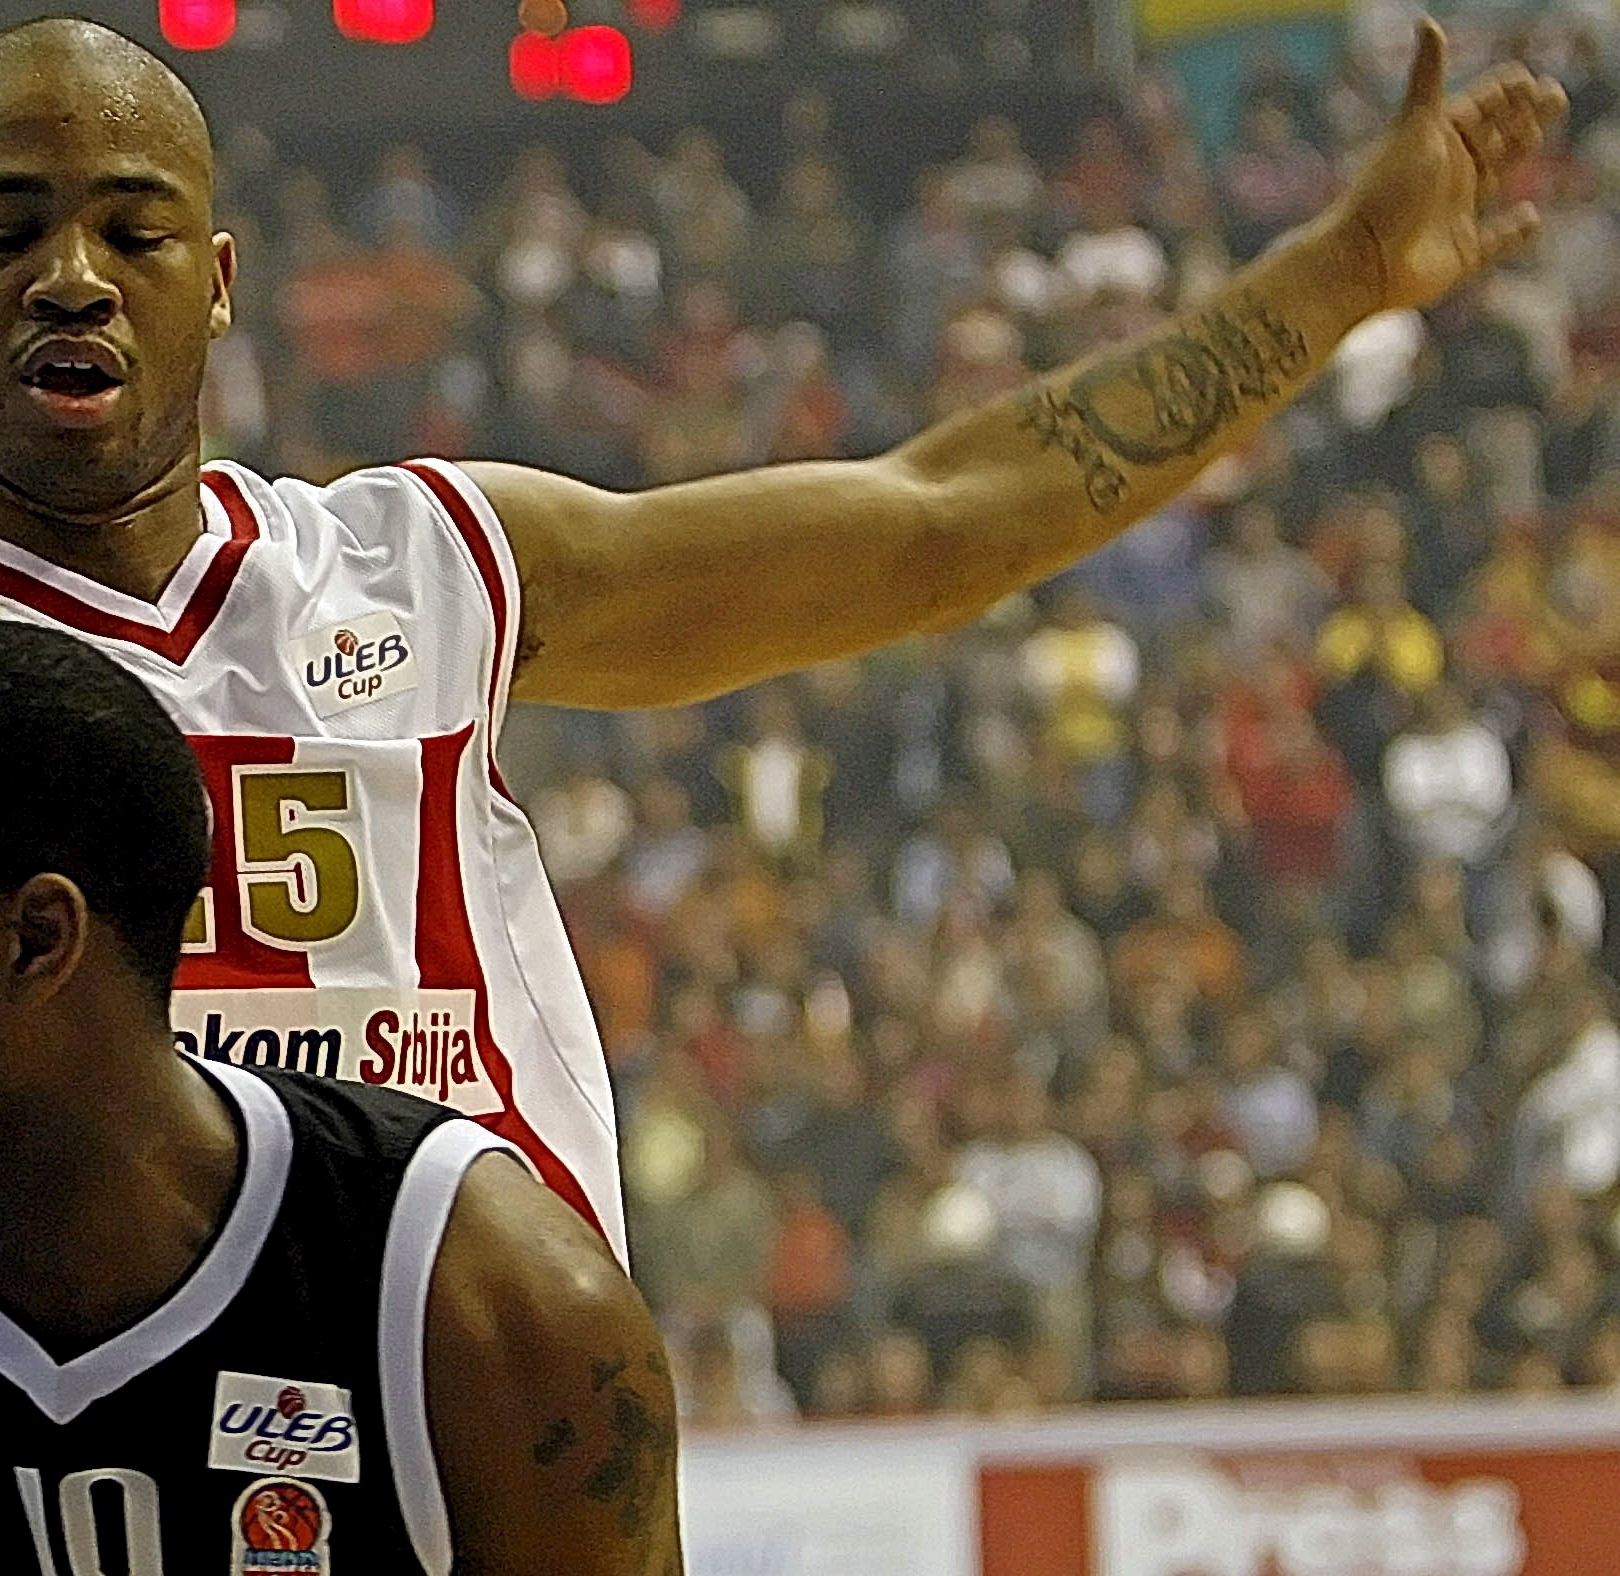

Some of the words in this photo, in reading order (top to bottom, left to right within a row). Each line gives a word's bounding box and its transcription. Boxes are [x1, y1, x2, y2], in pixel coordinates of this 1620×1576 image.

[306, 634, 408, 687] ULEB
[338, 674, 382, 699] Cup
[183, 765, 361, 953] 5
[360, 1010, 479, 1102] Srbija
[219, 1403, 352, 1452] ULEB
[244, 1439, 307, 1470] Cup
